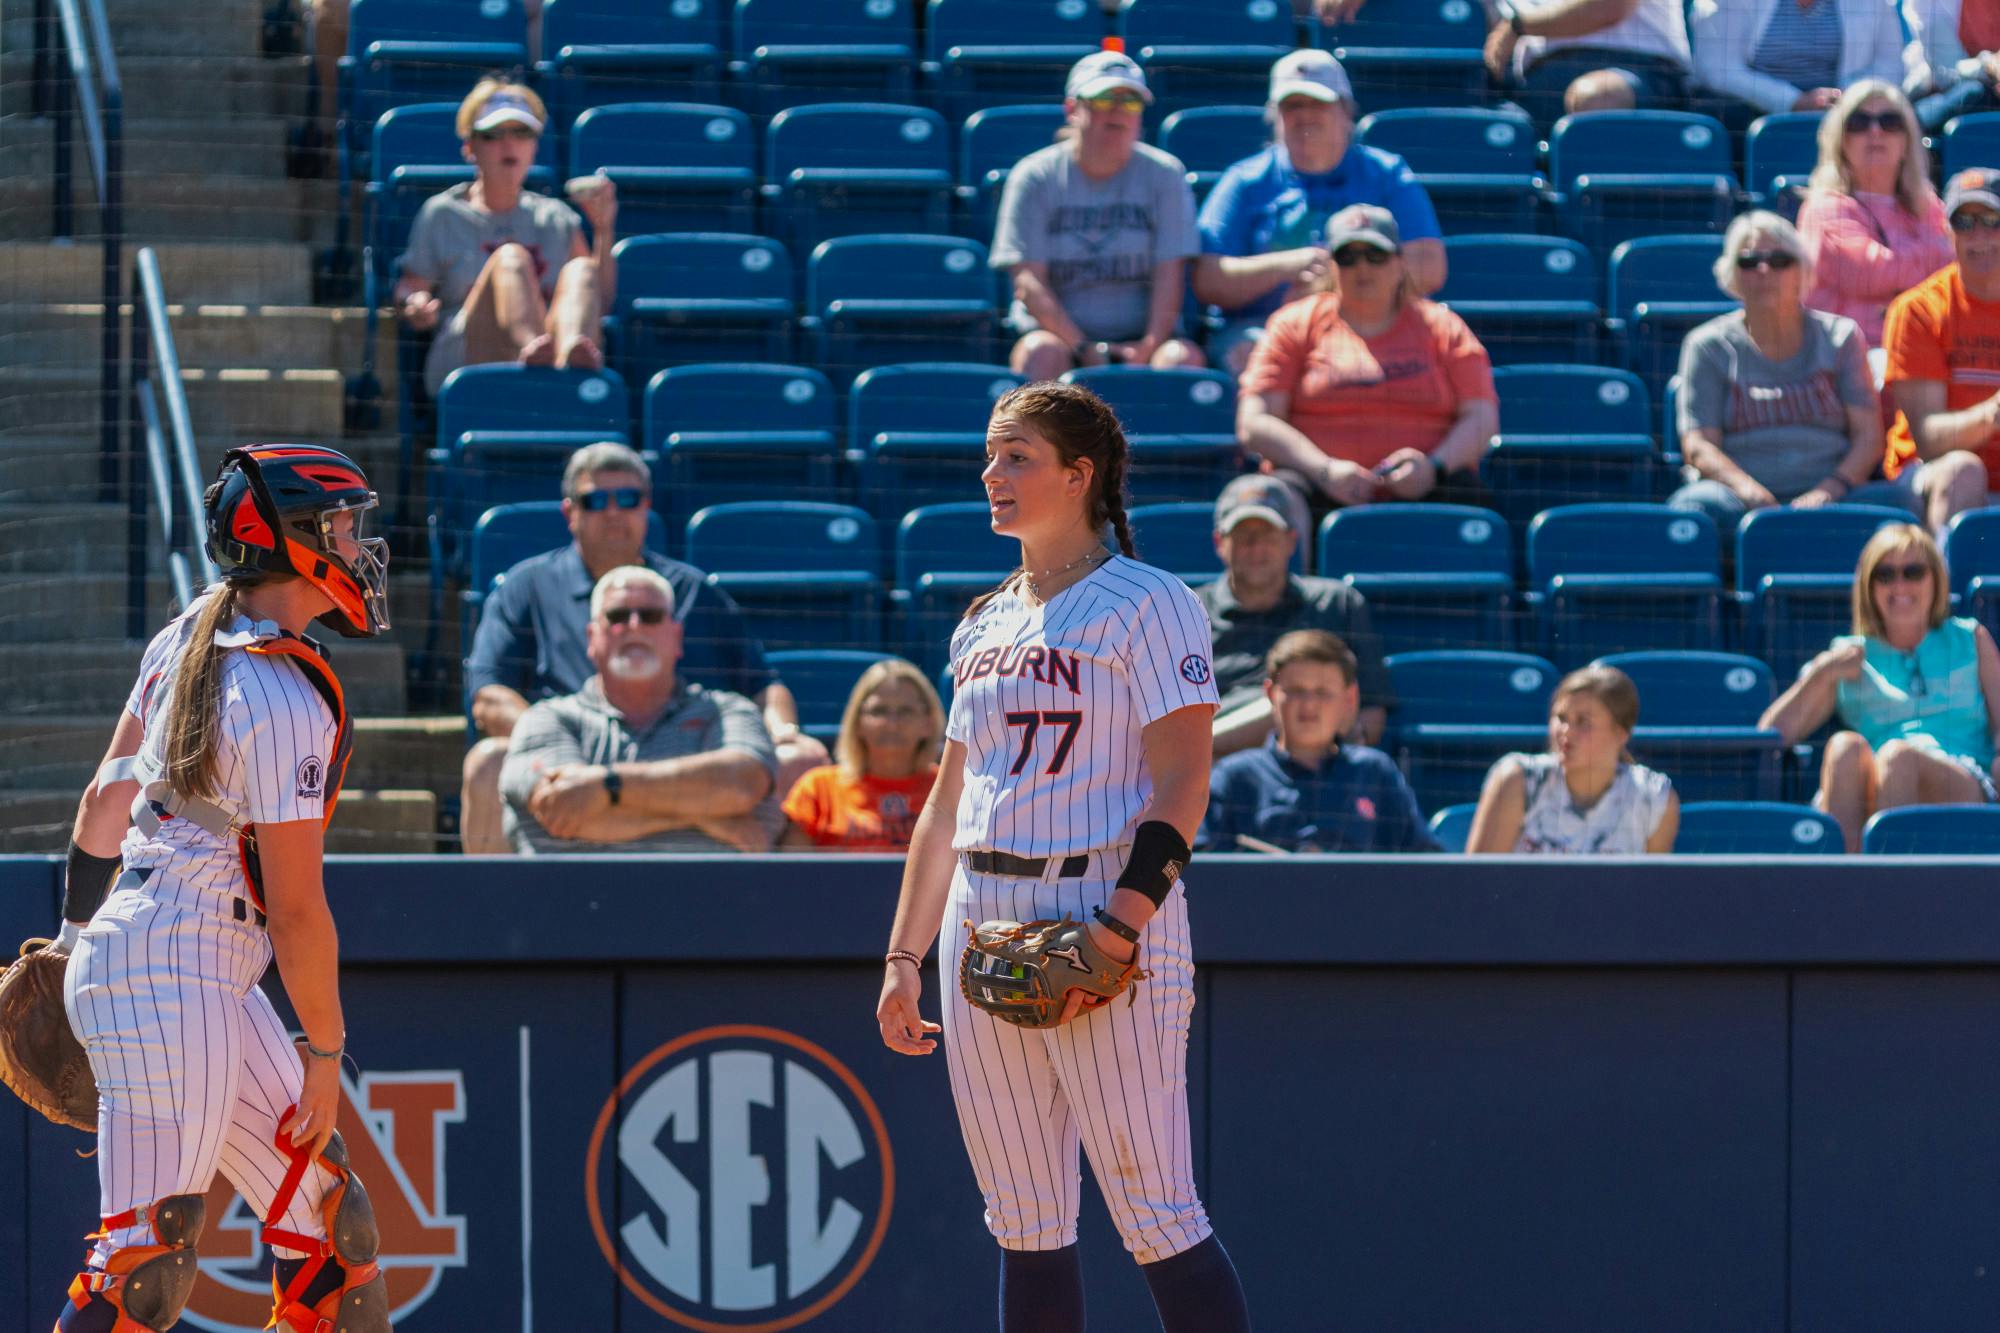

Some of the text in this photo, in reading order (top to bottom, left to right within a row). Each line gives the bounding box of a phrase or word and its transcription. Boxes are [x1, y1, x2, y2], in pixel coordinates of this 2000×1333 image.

[956, 645, 1081, 695] UBURN
[1182, 656, 1209, 683] SEC
[1006, 711, 1082, 775] 77
[617, 1049, 866, 1311] SEC
